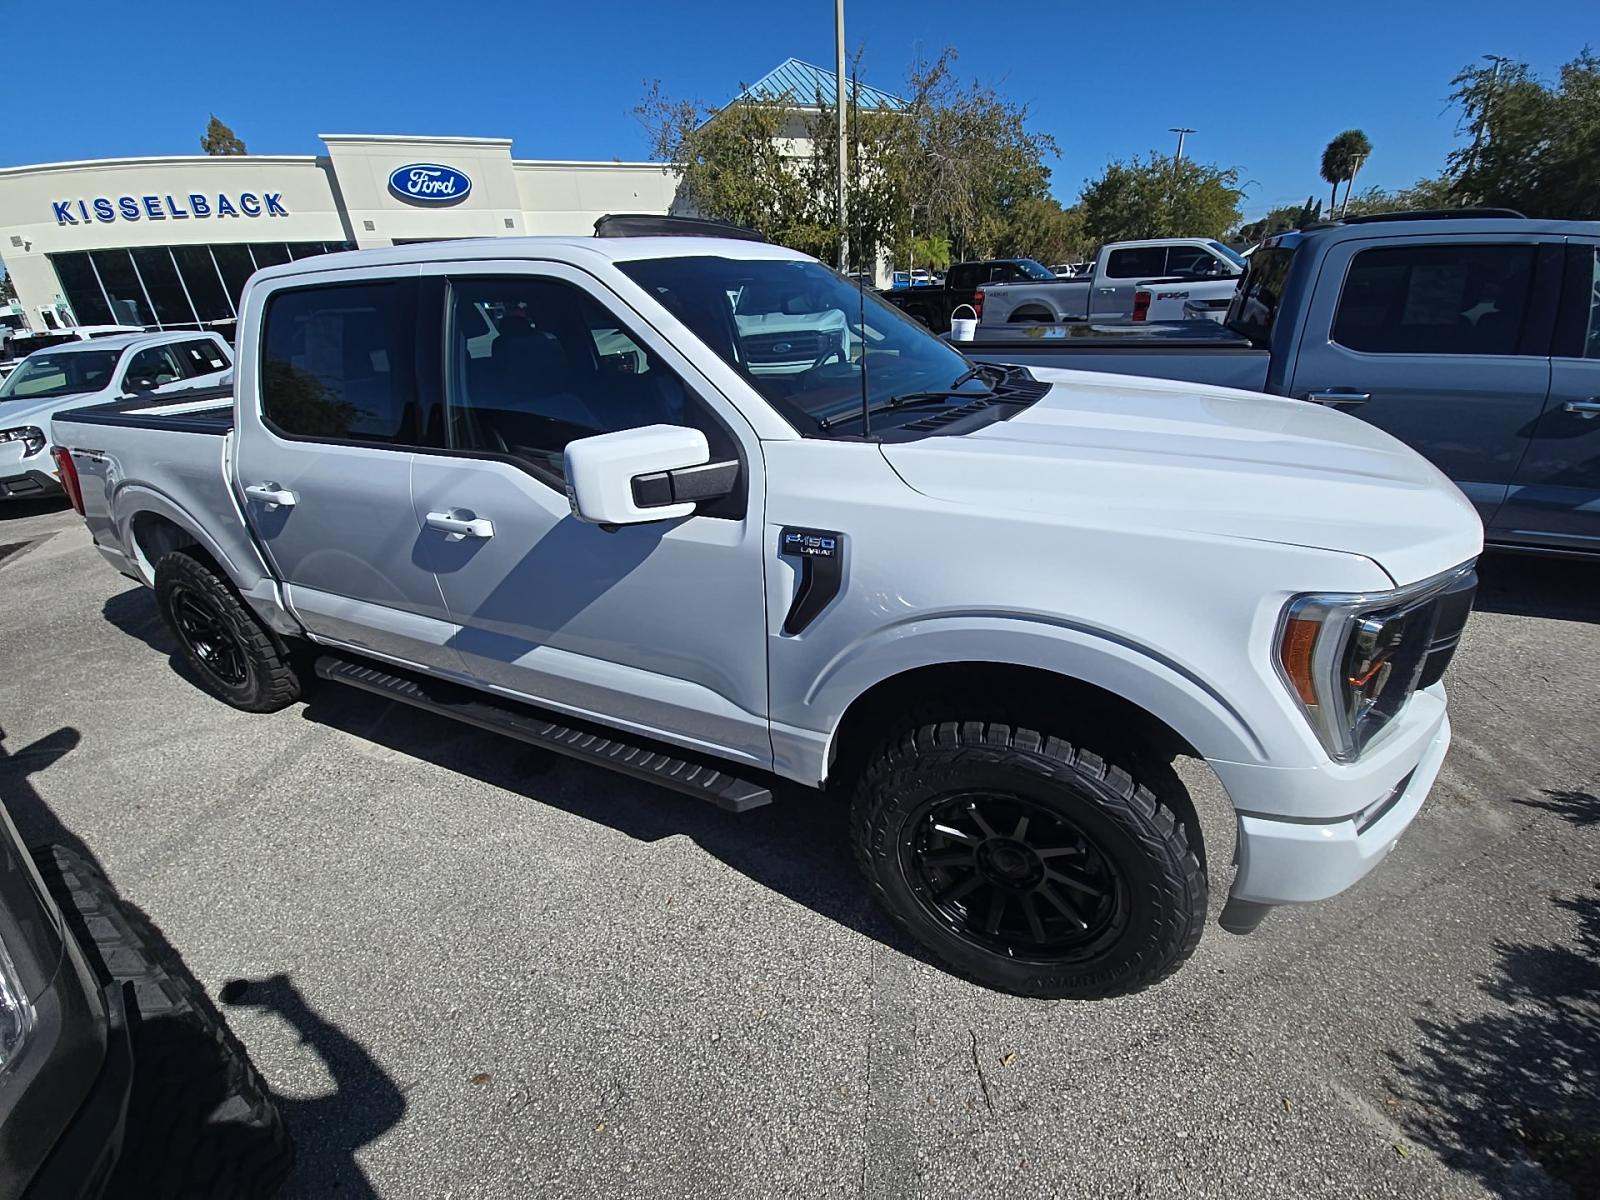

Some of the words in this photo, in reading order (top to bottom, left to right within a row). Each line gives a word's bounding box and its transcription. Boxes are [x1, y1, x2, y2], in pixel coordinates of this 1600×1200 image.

[407, 169, 456, 194] Ford
[52, 193, 288, 225] KISSELBACK
[786, 533, 835, 549] F-150
